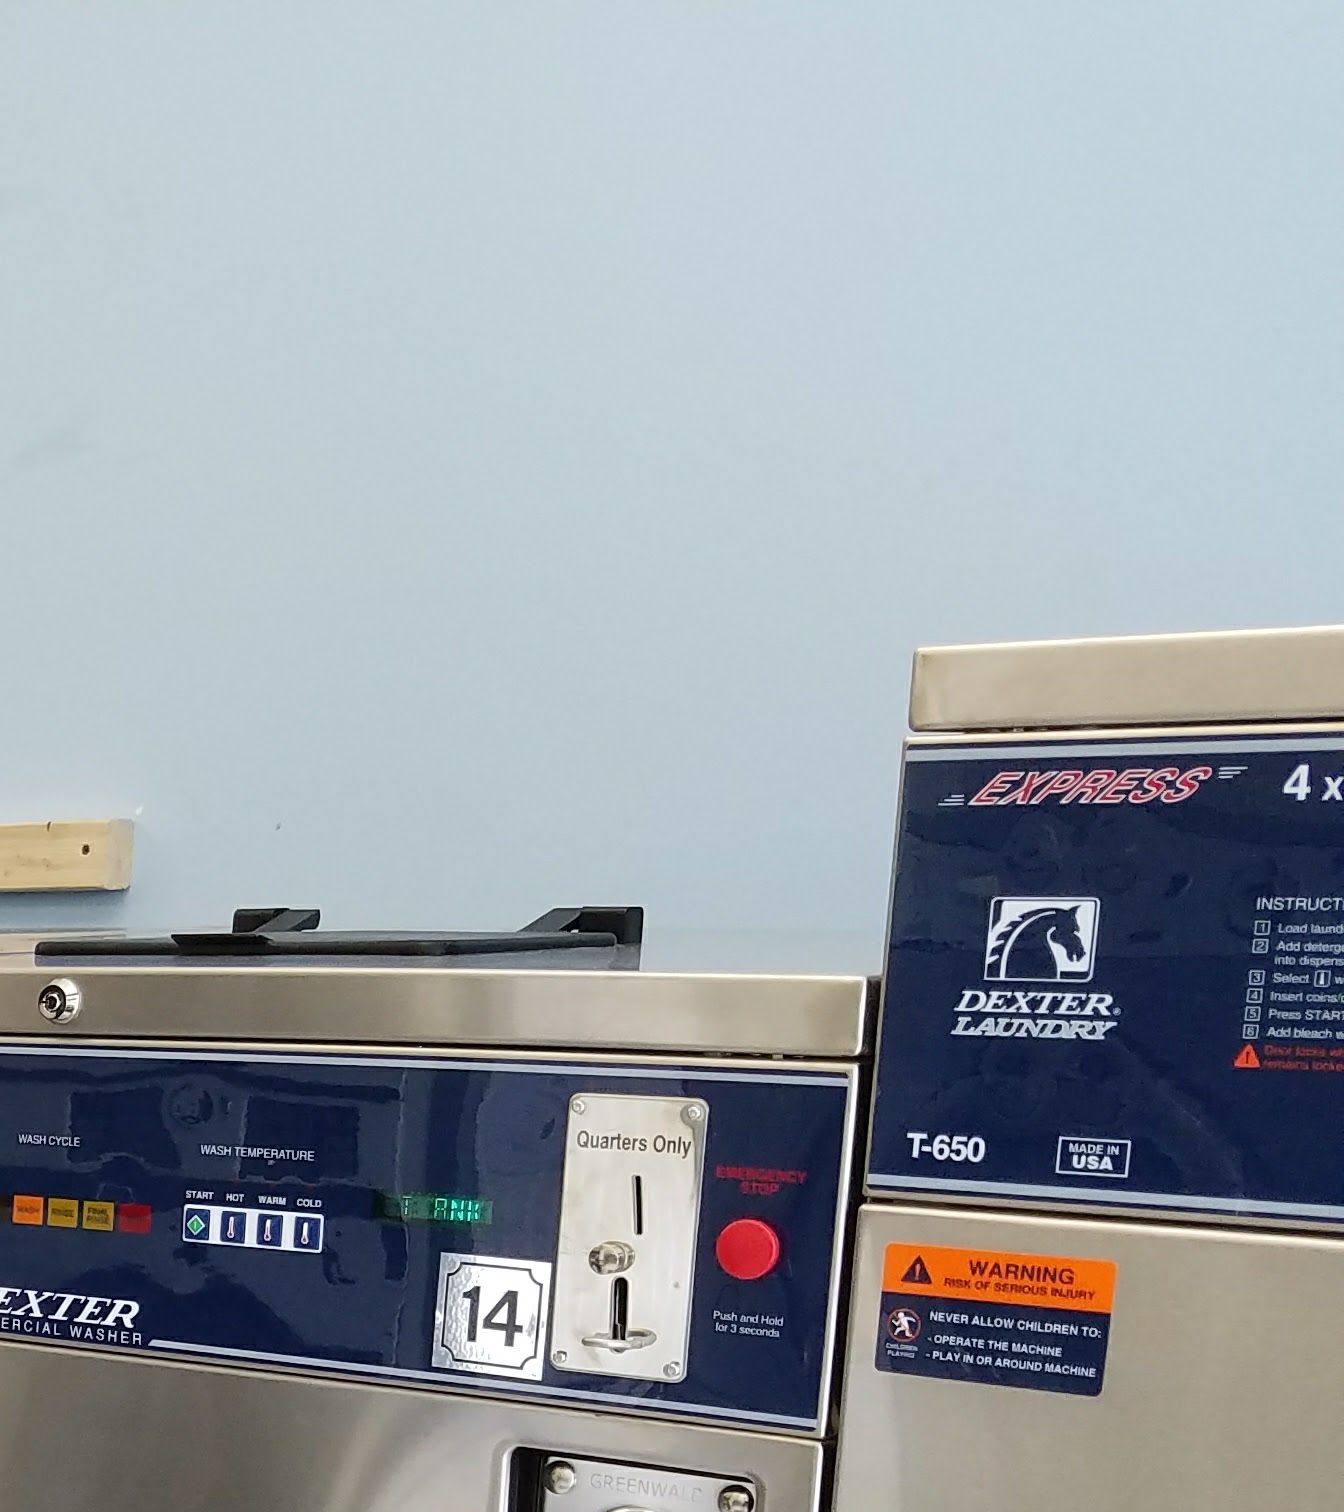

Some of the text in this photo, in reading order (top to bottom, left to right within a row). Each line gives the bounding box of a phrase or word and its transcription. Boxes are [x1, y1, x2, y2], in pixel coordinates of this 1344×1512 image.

[967, 763, 1311, 806] EXPRESS 4
[1276, 940, 1301, 952] Add
[1274, 956, 1296, 966] into
[1272, 973, 1310, 984] Select
[949, 1017, 1118, 1041] LAUNDRY
[1266, 1027, 1291, 1037] Add
[17, 1133, 81, 1149] WASH CYCLE
[576, 1130, 692, 1159] Quarters Only
[906, 1131, 987, 1164] T-650
[1068, 1142, 1121, 1156] MADE IN
[200, 1144, 315, 1162] WASH TEMPERATURE
[1070, 1153, 1115, 1172] USA
[185, 1189, 214, 1200] START
[226, 1193, 245, 1203] HOT
[258, 1195, 287, 1206] WARM
[296, 1198, 322, 1208] COLD
[969, 1259, 1075, 1286] WARNING
[943, 1277, 1095, 1301] RISK OF SERIOUS INJURY
[462, 1285, 525, 1348] 14
[712, 1310, 784, 1327] Push and Hold
[929, 1311, 1102, 1339] NEVER ALLOW CHILDREN TO:
[69, 1324, 144, 1347] WASHER
[730, 1324, 780, 1338] 3 seconds
[934, 1335, 1062, 1357] OPERATE THE MACHINE
[932, 1350, 1097, 1378] PLAY IN OR AROUND MACHINE
